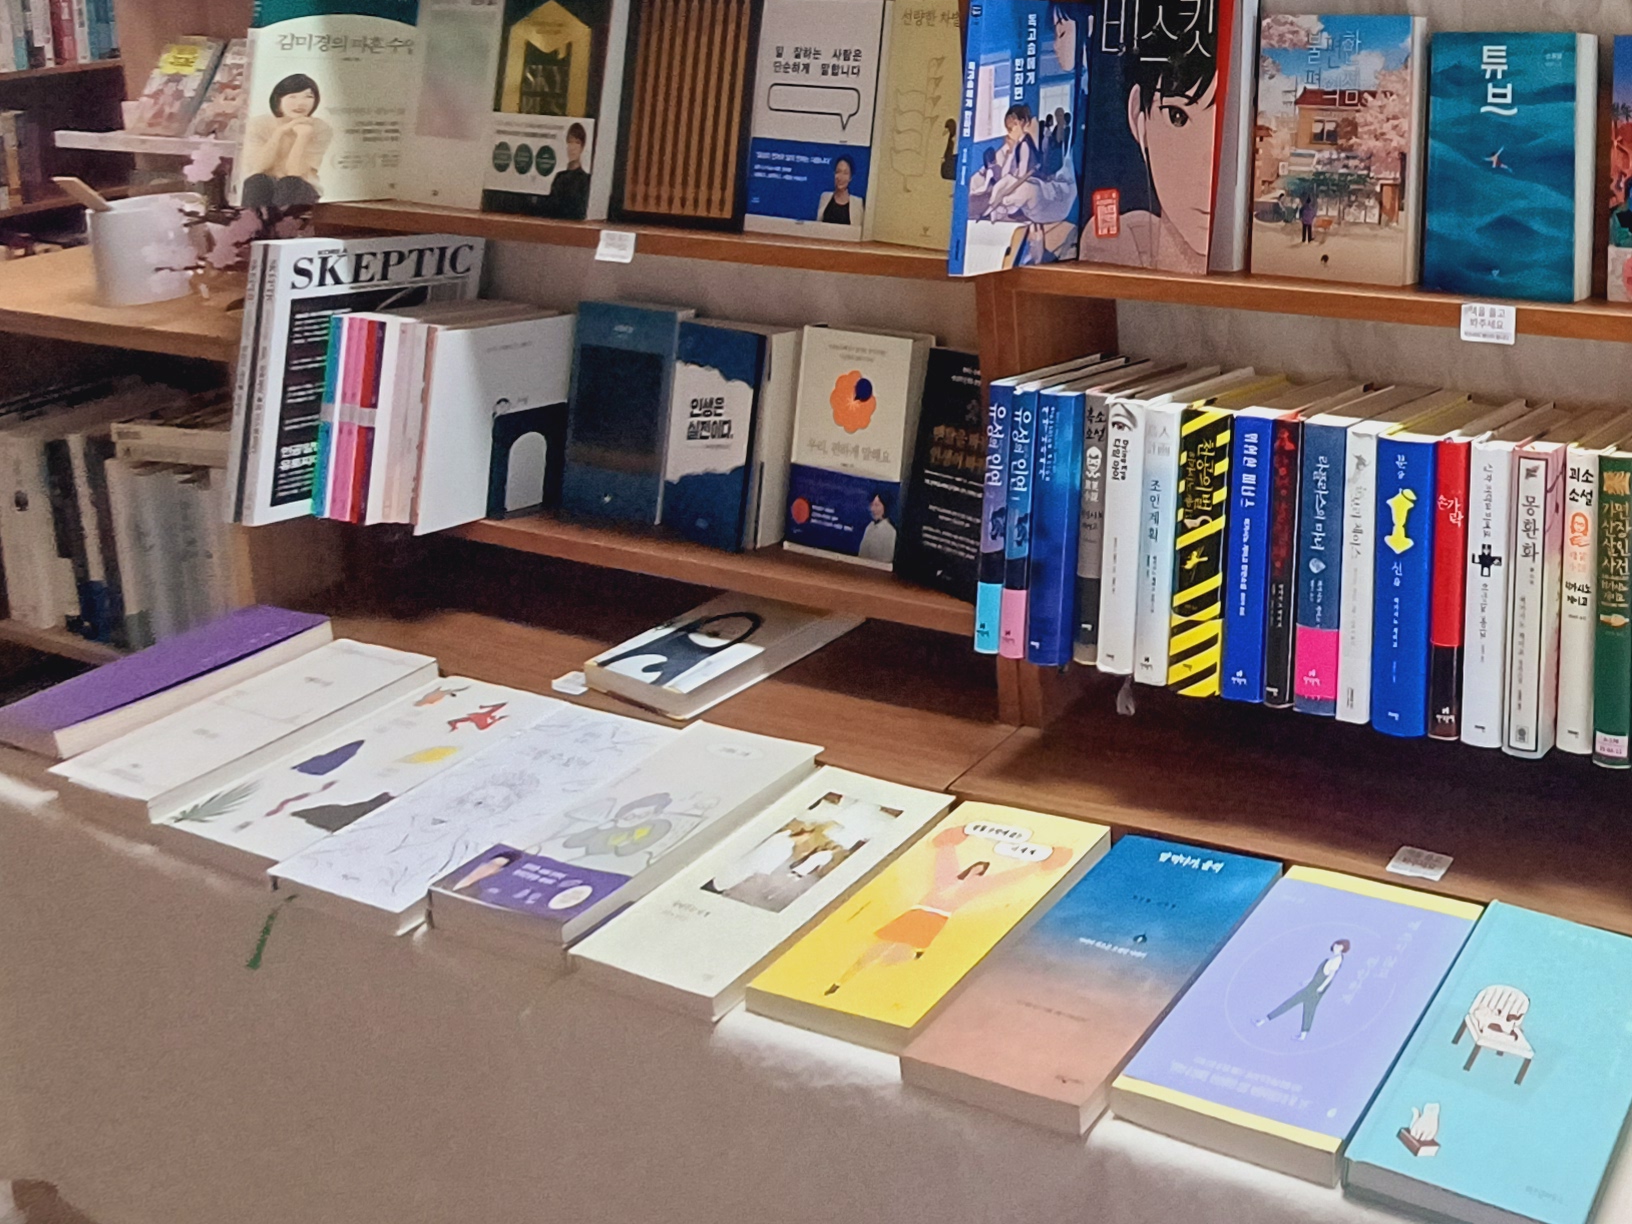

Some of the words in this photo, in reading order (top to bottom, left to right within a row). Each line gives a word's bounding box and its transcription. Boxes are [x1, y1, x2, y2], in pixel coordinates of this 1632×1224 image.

[276, 32, 349, 53] 김미경의
[792, 46, 823, 61] 잘하는
[831, 47, 863, 64] 사람은
[772, 60, 812, 76] 단순하게
[819, 62, 862, 78] 말합니다
[1479, 44, 1519, 117] 튜브
[290, 242, 475, 292] SKEPTIC
[689, 395, 726, 419] 인생은
[686, 419, 734, 441] 실전이다.
[986, 404, 1007, 451] 유성의
[1010, 406, 1032, 455] 유성의
[1243, 432, 1260, 469] 위험한
[1195, 438, 1216, 492] 천공의
[1568, 468, 1595, 484] 괴소
[1240, 473, 1258, 509] 비너스
[1311, 454, 1330, 520] 라플라스의
[1568, 489, 1594, 507] 소설
[1602, 502, 1630, 521] 가면
[1309, 521, 1326, 551] 마녀
[1521, 495, 1539, 564] 몽환화
[1601, 520, 1632, 538] 산장
[1601, 538, 1632, 558] 살인
[1601, 558, 1630, 576] 사건
